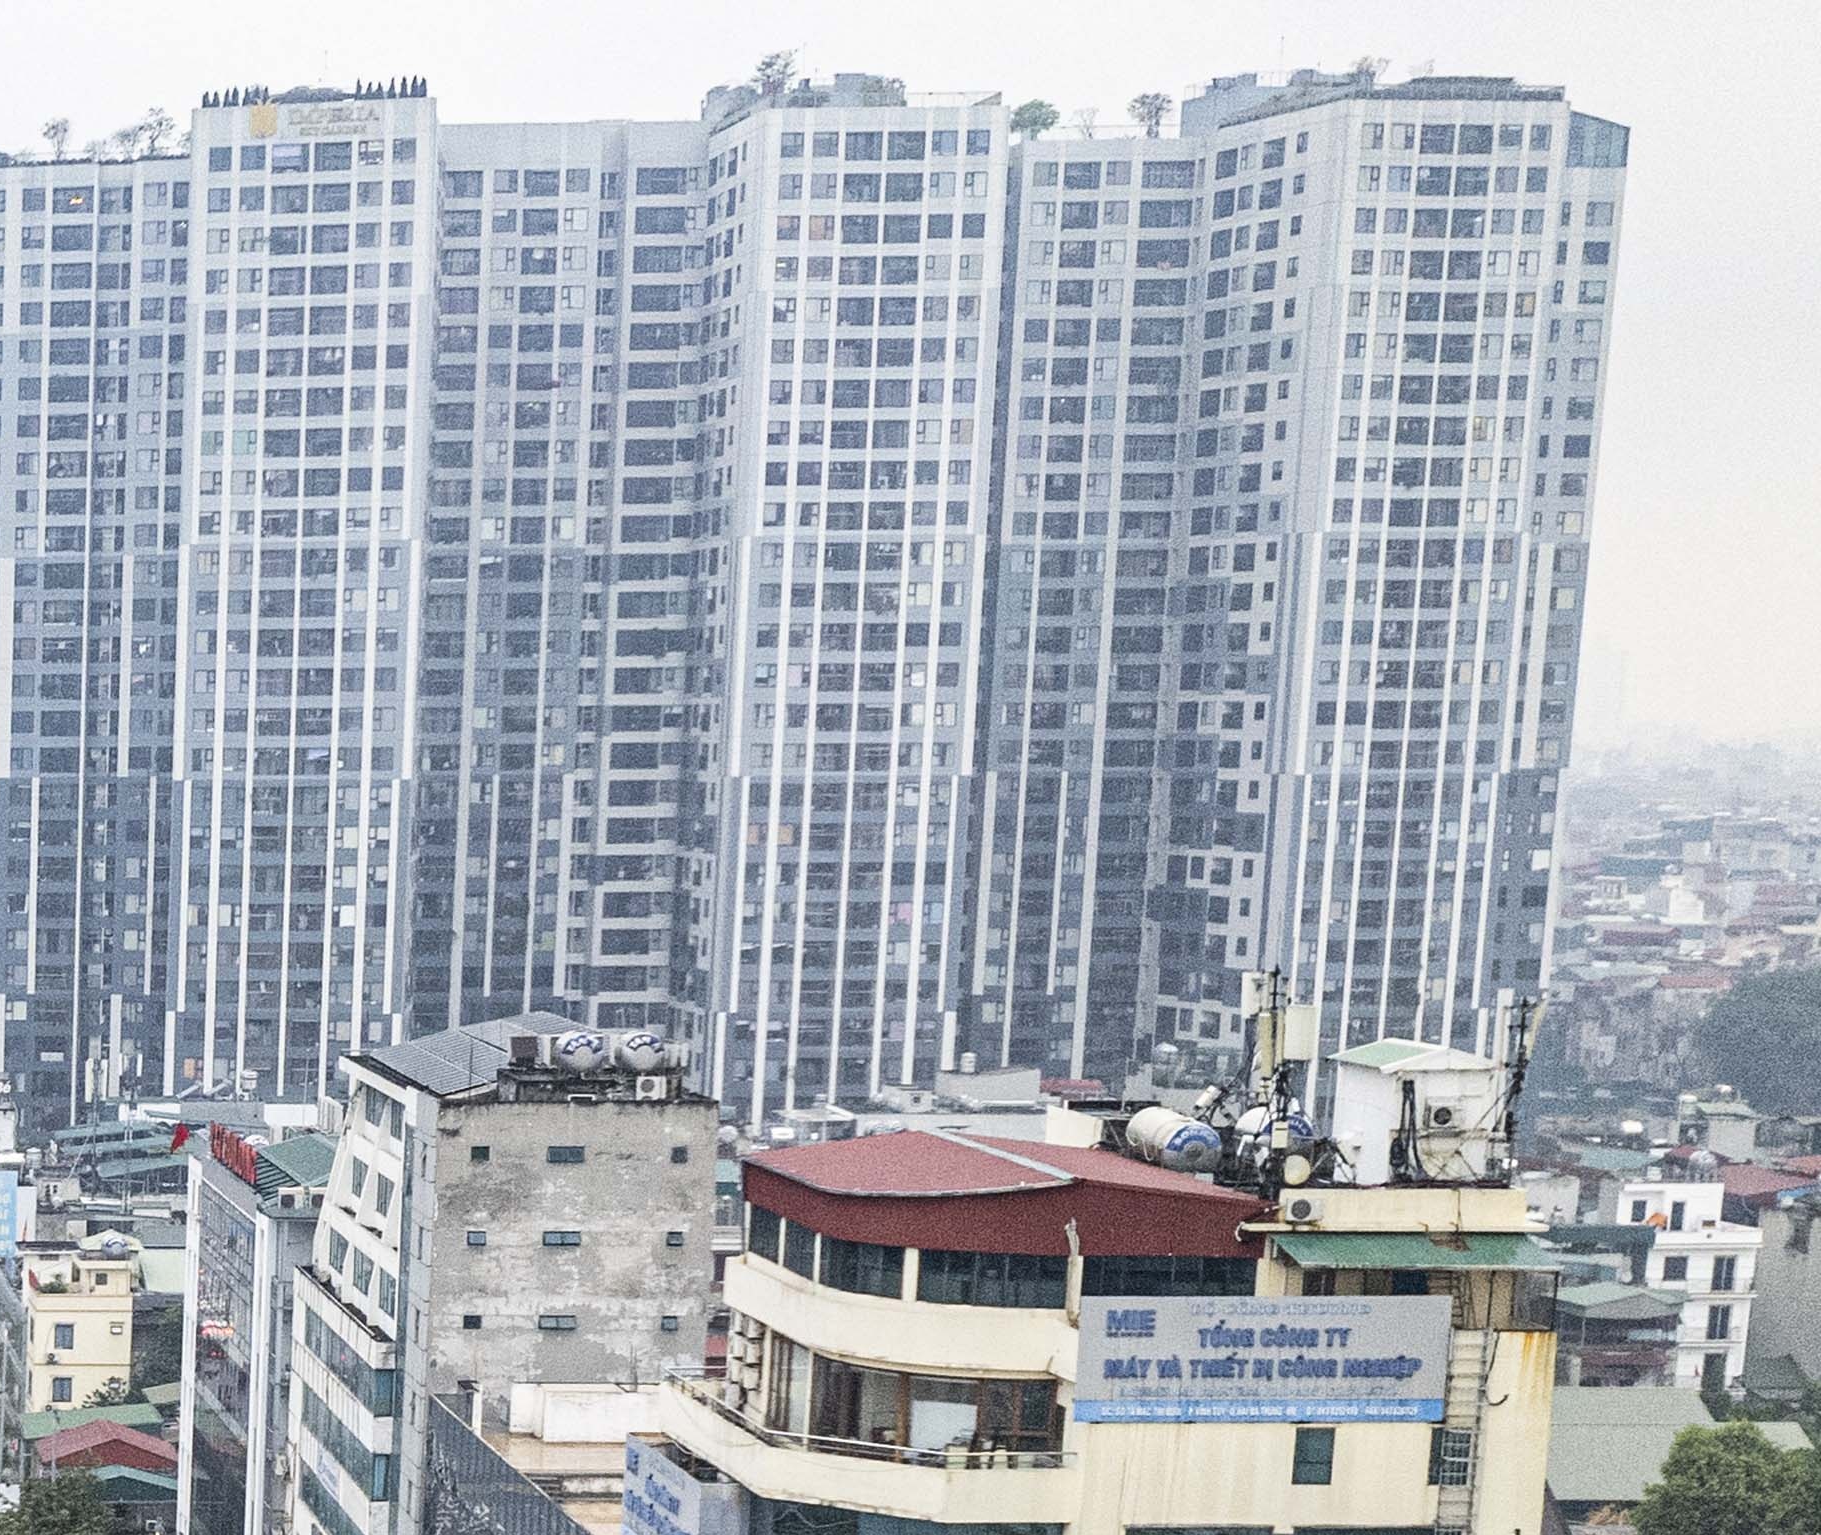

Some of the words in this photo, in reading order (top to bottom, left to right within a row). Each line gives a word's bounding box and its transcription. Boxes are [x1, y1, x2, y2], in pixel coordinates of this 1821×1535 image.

[1106, 1309, 1157, 1331] MIE
[1198, 1319, 1255, 1348] TỔNG
[1259, 1323, 1320, 1348] CÔNG
[1324, 1327, 1353, 1348] TY
[1103, 1355, 1153, 1379] MÁY
[1278, 1355, 1338, 1379] CÔNG
